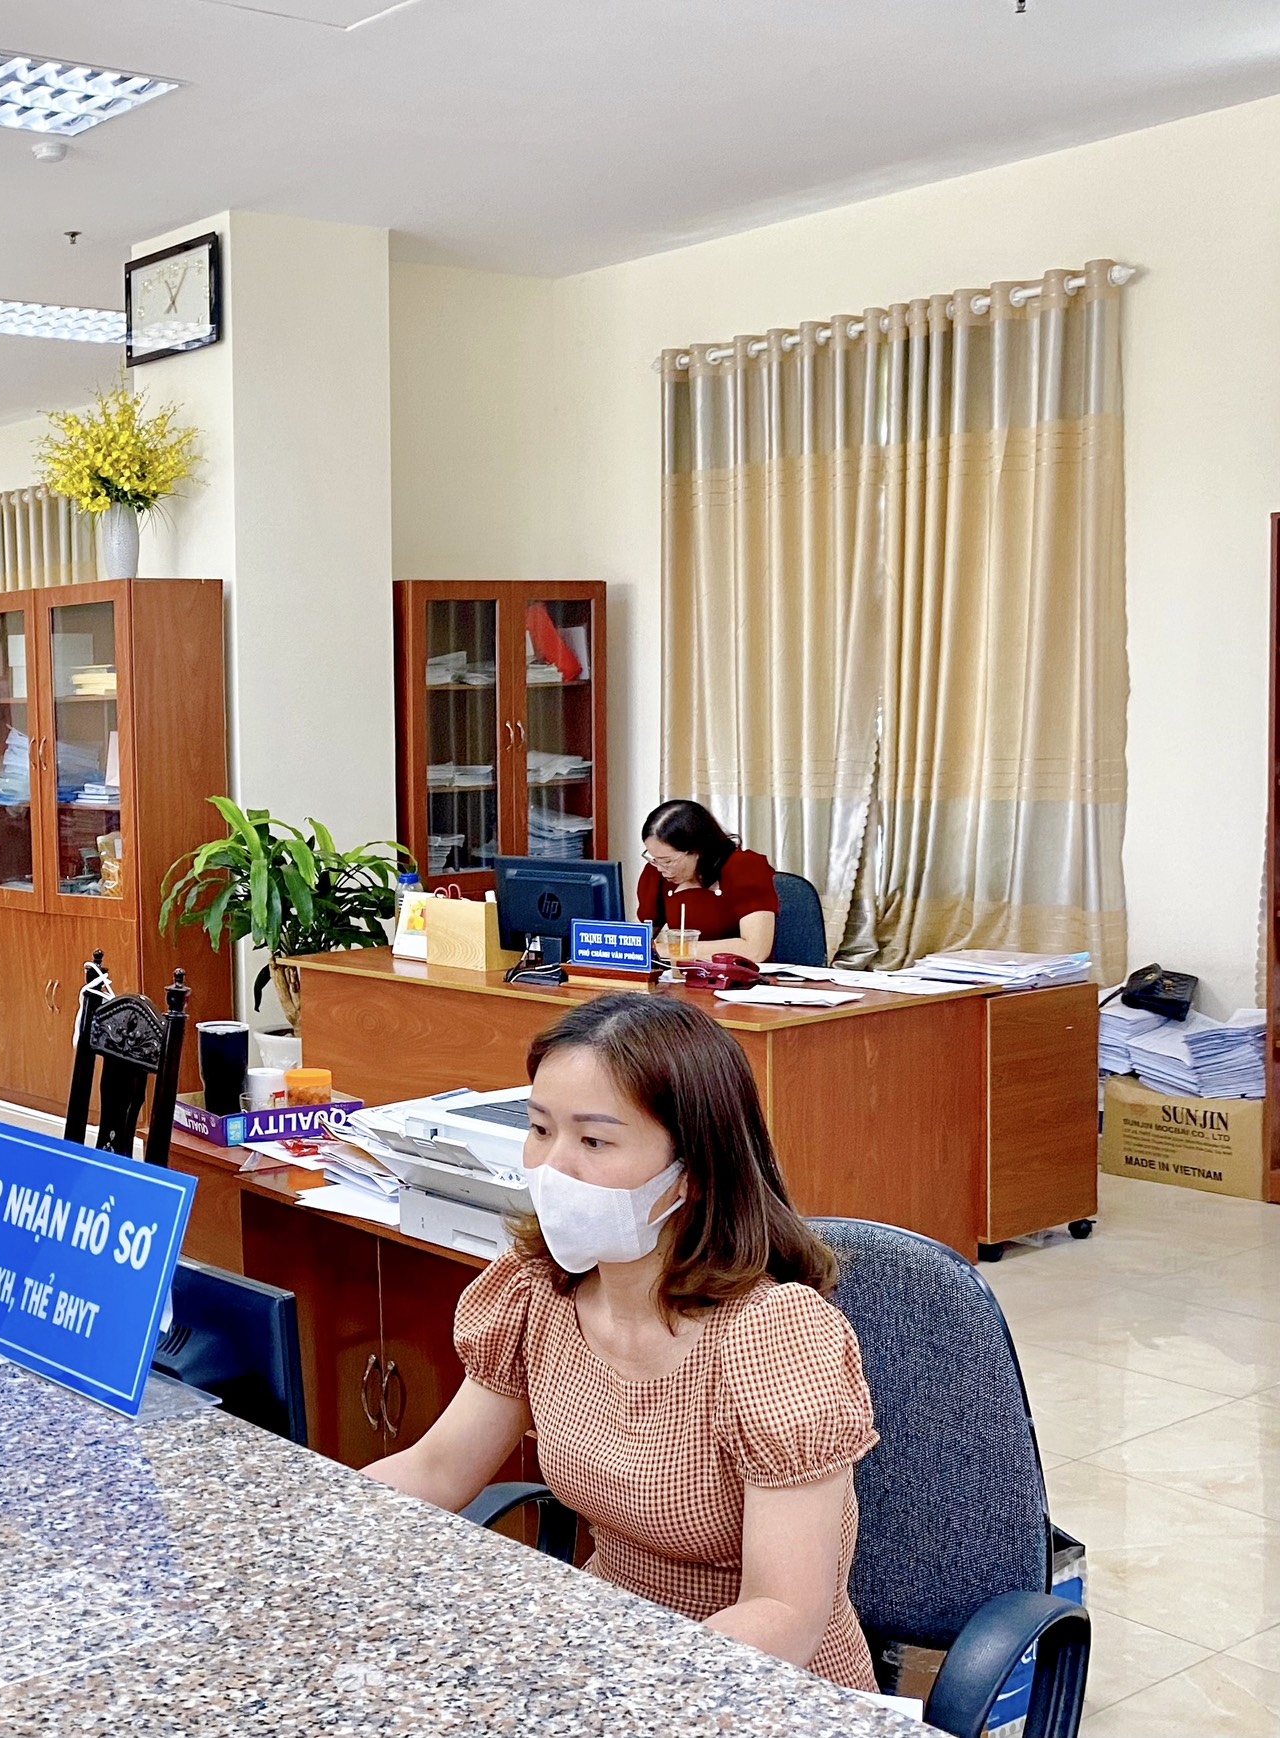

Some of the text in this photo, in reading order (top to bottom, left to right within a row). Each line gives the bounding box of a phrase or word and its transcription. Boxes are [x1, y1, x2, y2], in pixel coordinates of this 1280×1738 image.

[541, 891, 560, 920] hp
[578, 948, 590, 957] PHÓ
[579, 932, 602, 946] TRỊNH
[604, 934, 617, 947] THỊ
[249, 1109, 347, 1137] QUALITY
[1161, 1104, 1229, 1131] SUNJIN
[1211, 1133, 1231, 1142] LTD
[1124, 1155, 1223, 1182] MADE IN VIETNAM
[3, 1183, 72, 1244] NHẬN
[71, 1195, 116, 1257] HỒ
[113, 1222, 158, 1271] SƠ
[20, 1272, 54, 1320] THẺ
[53, 1294, 100, 1339] BHYT
